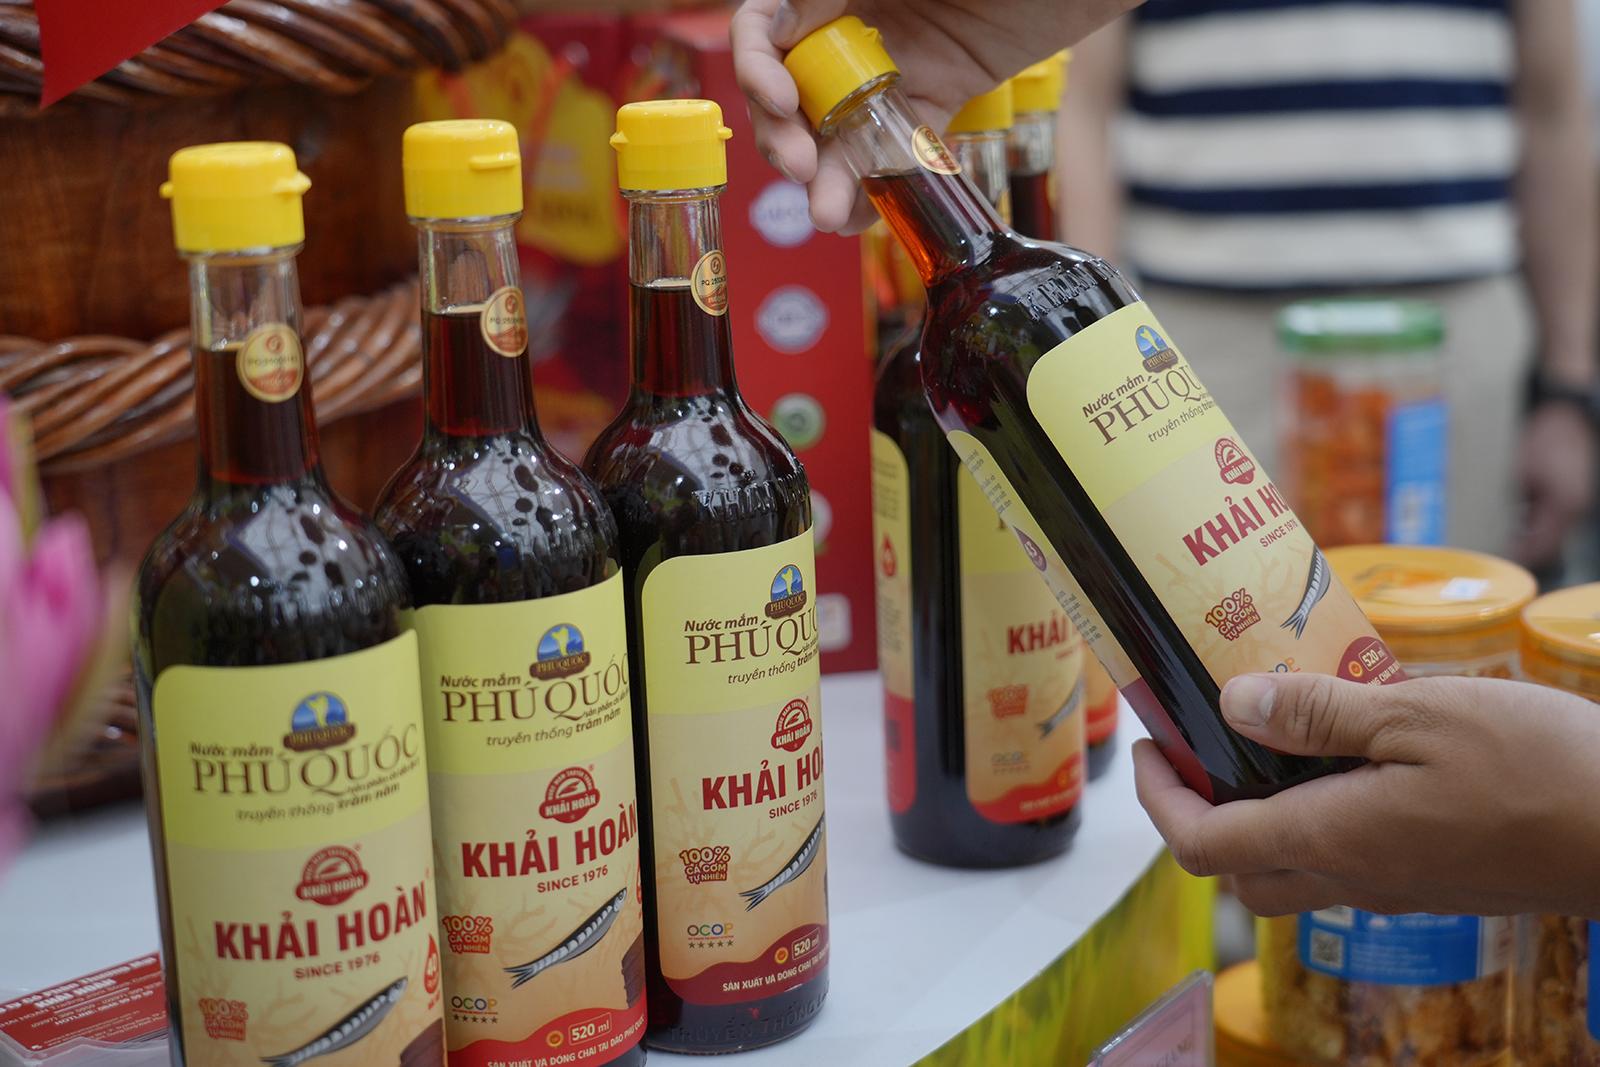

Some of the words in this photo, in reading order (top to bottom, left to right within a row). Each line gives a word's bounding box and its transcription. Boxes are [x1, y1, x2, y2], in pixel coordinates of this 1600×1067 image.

[1089, 376, 1170, 446] PHÚ
[1182, 495, 1266, 566] KHẢI
[1260, 526, 1287, 548] SINCE
[1205, 587, 1253, 627] 100%
[684, 618, 722, 632] Nước
[724, 612, 758, 629] mắm
[684, 620, 772, 665] PHÚ
[1362, 649, 1380, 667] 520
[440, 674, 478, 689] Nước
[728, 668, 766, 684] truyền
[768, 661, 796, 678] thống
[441, 680, 540, 722] PHÚ
[486, 732, 532, 748] truyền
[535, 726, 573, 740] thống
[192, 752, 293, 795] PHÚ
[299, 723, 418, 798] QUỐC
[702, 760, 786, 810] KHẢI
[769, 800, 800, 819] SINCE
[462, 829, 559, 878] KHẢI
[679, 846, 731, 865] 100%
[537, 875, 579, 893] SINCE
[582, 864, 609, 883] 1976
[214, 910, 319, 961] KHẢI
[336, 881, 427, 952] HOÀN
[443, 915, 494, 934] 100%
[687, 923, 734, 937] OCOP
[794, 938, 811, 957] 520
[293, 960, 343, 979] SINCE
[347, 951, 381, 972] 1976
[451, 995, 497, 1011] OCOP
[571, 1023, 596, 1041] 520
[597, 1019, 610, 1032] ml
